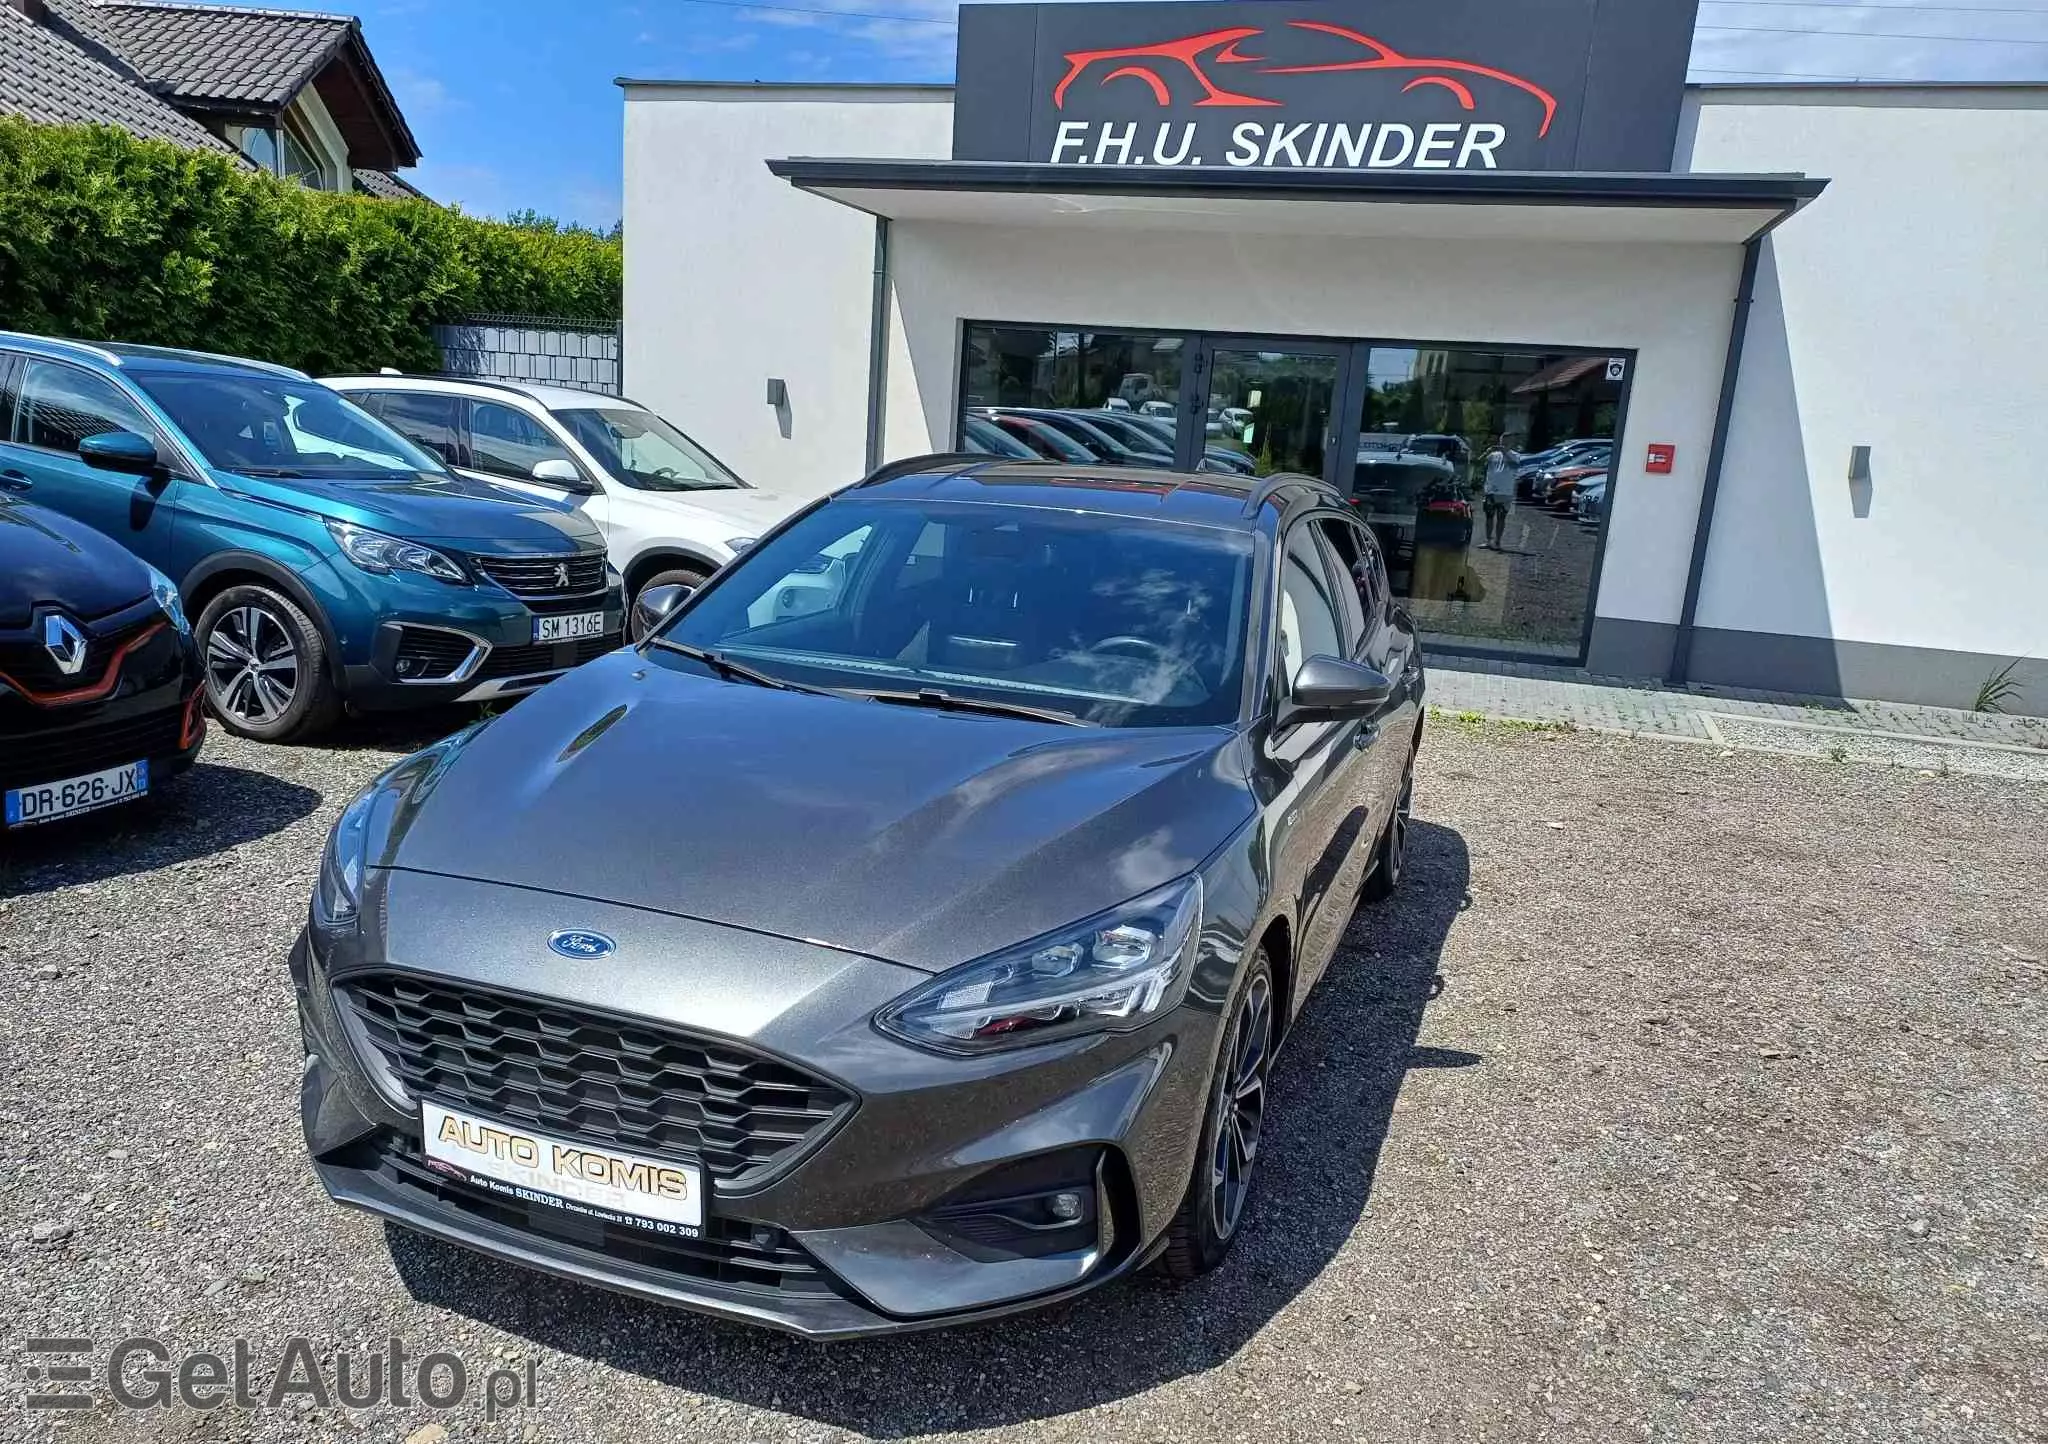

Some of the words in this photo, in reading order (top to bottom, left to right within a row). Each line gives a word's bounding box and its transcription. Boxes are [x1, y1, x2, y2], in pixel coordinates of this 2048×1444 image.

[1049, 120, 1202, 166] F.H.U.
[1225, 121, 1507, 169] SKINDER
[542, 618, 560, 639] SM
[565, 613, 602, 636] 1316E
[438, 1115, 540, 1169] AUTO
[551, 1144, 688, 1202] KOMIS
[470, 1175, 488, 1188] Auto
[489, 1180, 514, 1196] Komis
[515, 1187, 565, 1210] SKINDER
[635, 1218, 655, 1231] 793
[656, 1222, 677, 1235] 002
[679, 1226, 699, 1238] 309
